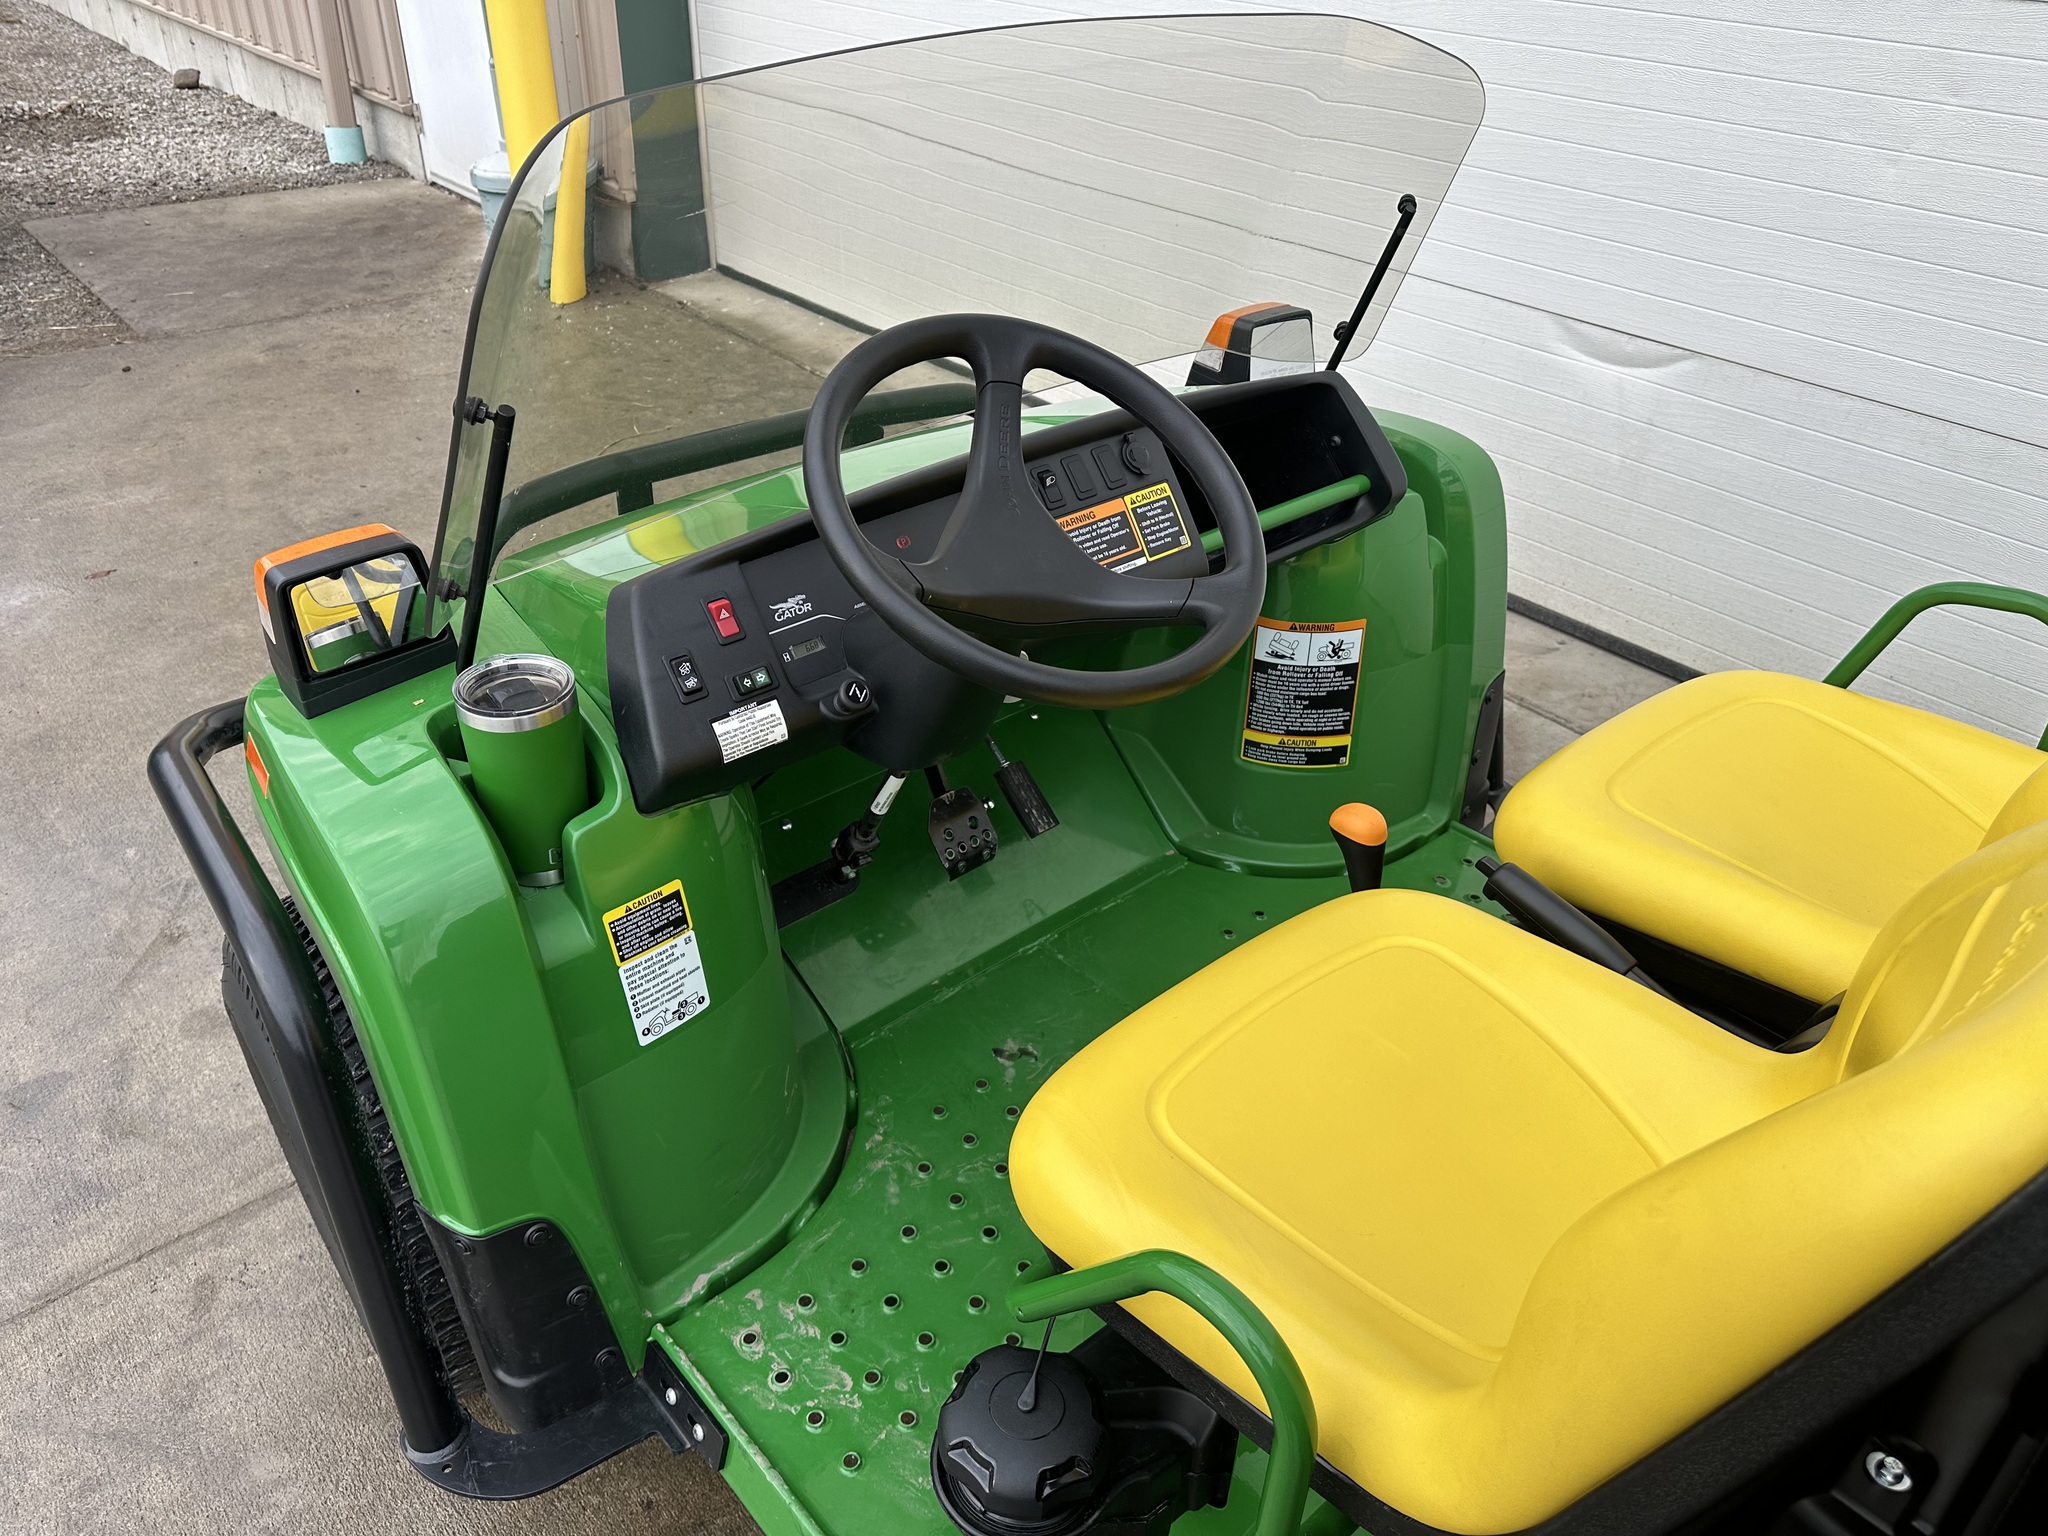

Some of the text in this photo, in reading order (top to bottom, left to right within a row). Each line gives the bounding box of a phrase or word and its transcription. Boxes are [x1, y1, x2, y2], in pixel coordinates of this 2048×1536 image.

[998, 403, 1010, 470] DEERE
[1136, 487, 1167, 503] CAUTION
[1151, 500, 1167, 508] Leaving
[1073, 534, 1091, 542] Rollover
[774, 602, 812, 622] GATOR
[805, 641, 820, 653] 668
[729, 702, 756, 715] IMPORTANT
[633, 890, 663, 909] CAUTION
[614, 918, 626, 926] Avoid
[628, 906, 650, 920] equipment
[616, 915, 644, 931] Accumulation
[650, 907, 661, 915] grass,
[663, 899, 676, 908] leaves
[638, 917, 651, 926] debris
[620, 912, 683, 945] Inspect machine before, during,
[624, 928, 640, 937] moving
[624, 948, 642, 958] machine
[657, 934, 670, 942] before
[671, 924, 687, 935] cleaning.
[640, 937, 654, 946] engine
[624, 961, 643, 974] Inspect
[644, 956, 654, 964] and
[655, 948, 668, 958] clean
[626, 952, 674, 980] entire machine and
[638, 968, 656, 981] special
[658, 956, 679, 970] attention
[629, 970, 668, 992] these locations:
